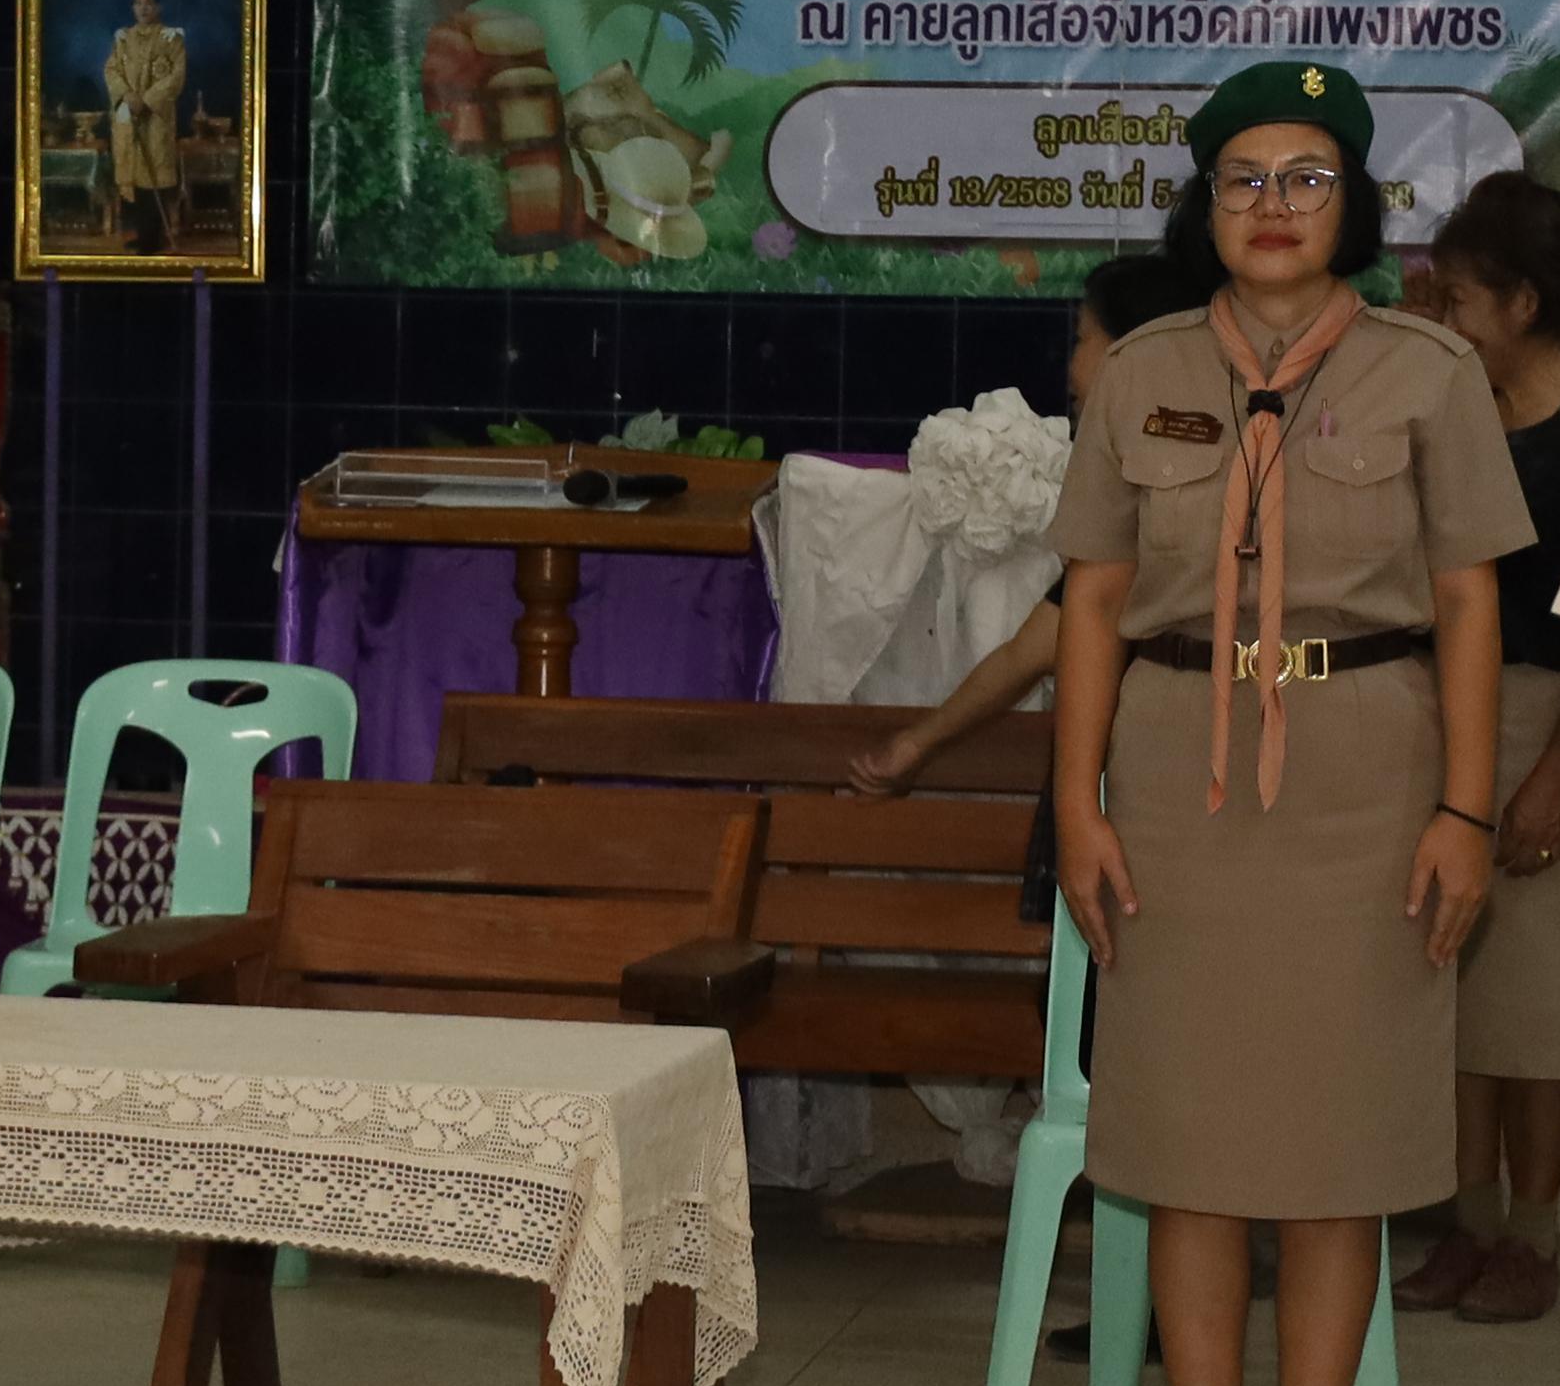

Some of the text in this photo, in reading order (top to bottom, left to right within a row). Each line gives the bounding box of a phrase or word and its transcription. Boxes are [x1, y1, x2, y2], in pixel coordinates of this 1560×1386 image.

[798, 0, 845, 41] ณ
[875, 156, 941, 218] รุ่นที่
[948, 174, 1073, 209] 13/2568
[1079, 158, 1145, 210] วันที่
